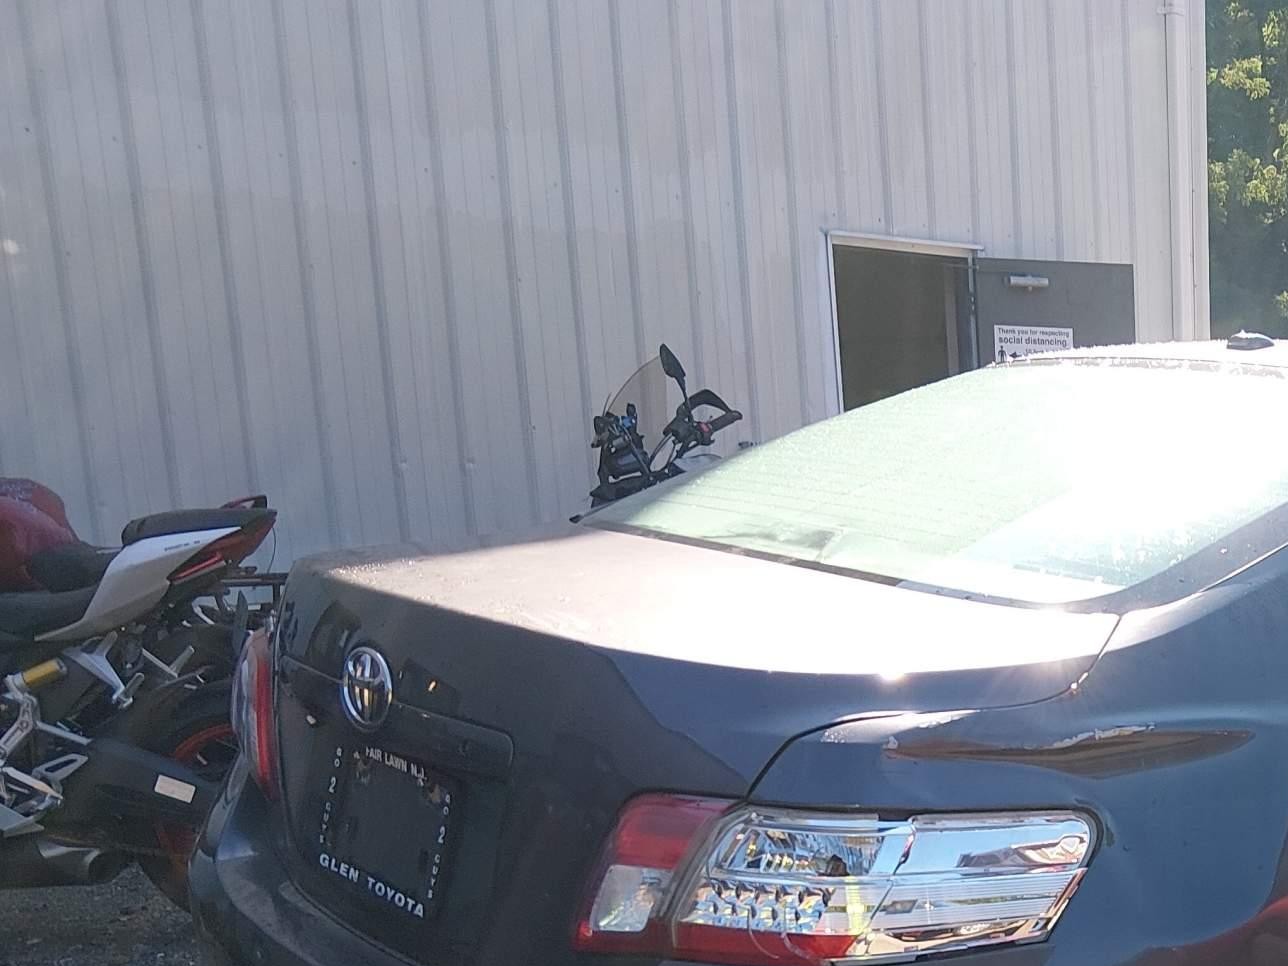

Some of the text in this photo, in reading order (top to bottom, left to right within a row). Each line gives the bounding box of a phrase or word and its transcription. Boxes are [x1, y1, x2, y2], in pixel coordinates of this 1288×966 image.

[998, 327, 1016, 335] Thank
[1017, 329, 1029, 337] you
[1039, 330, 1070, 338] respecting
[998, 336, 1067, 347] social distancing
[384, 752, 407, 773] LAWN
[319, 853, 425, 918] GLEN TOYOTA
